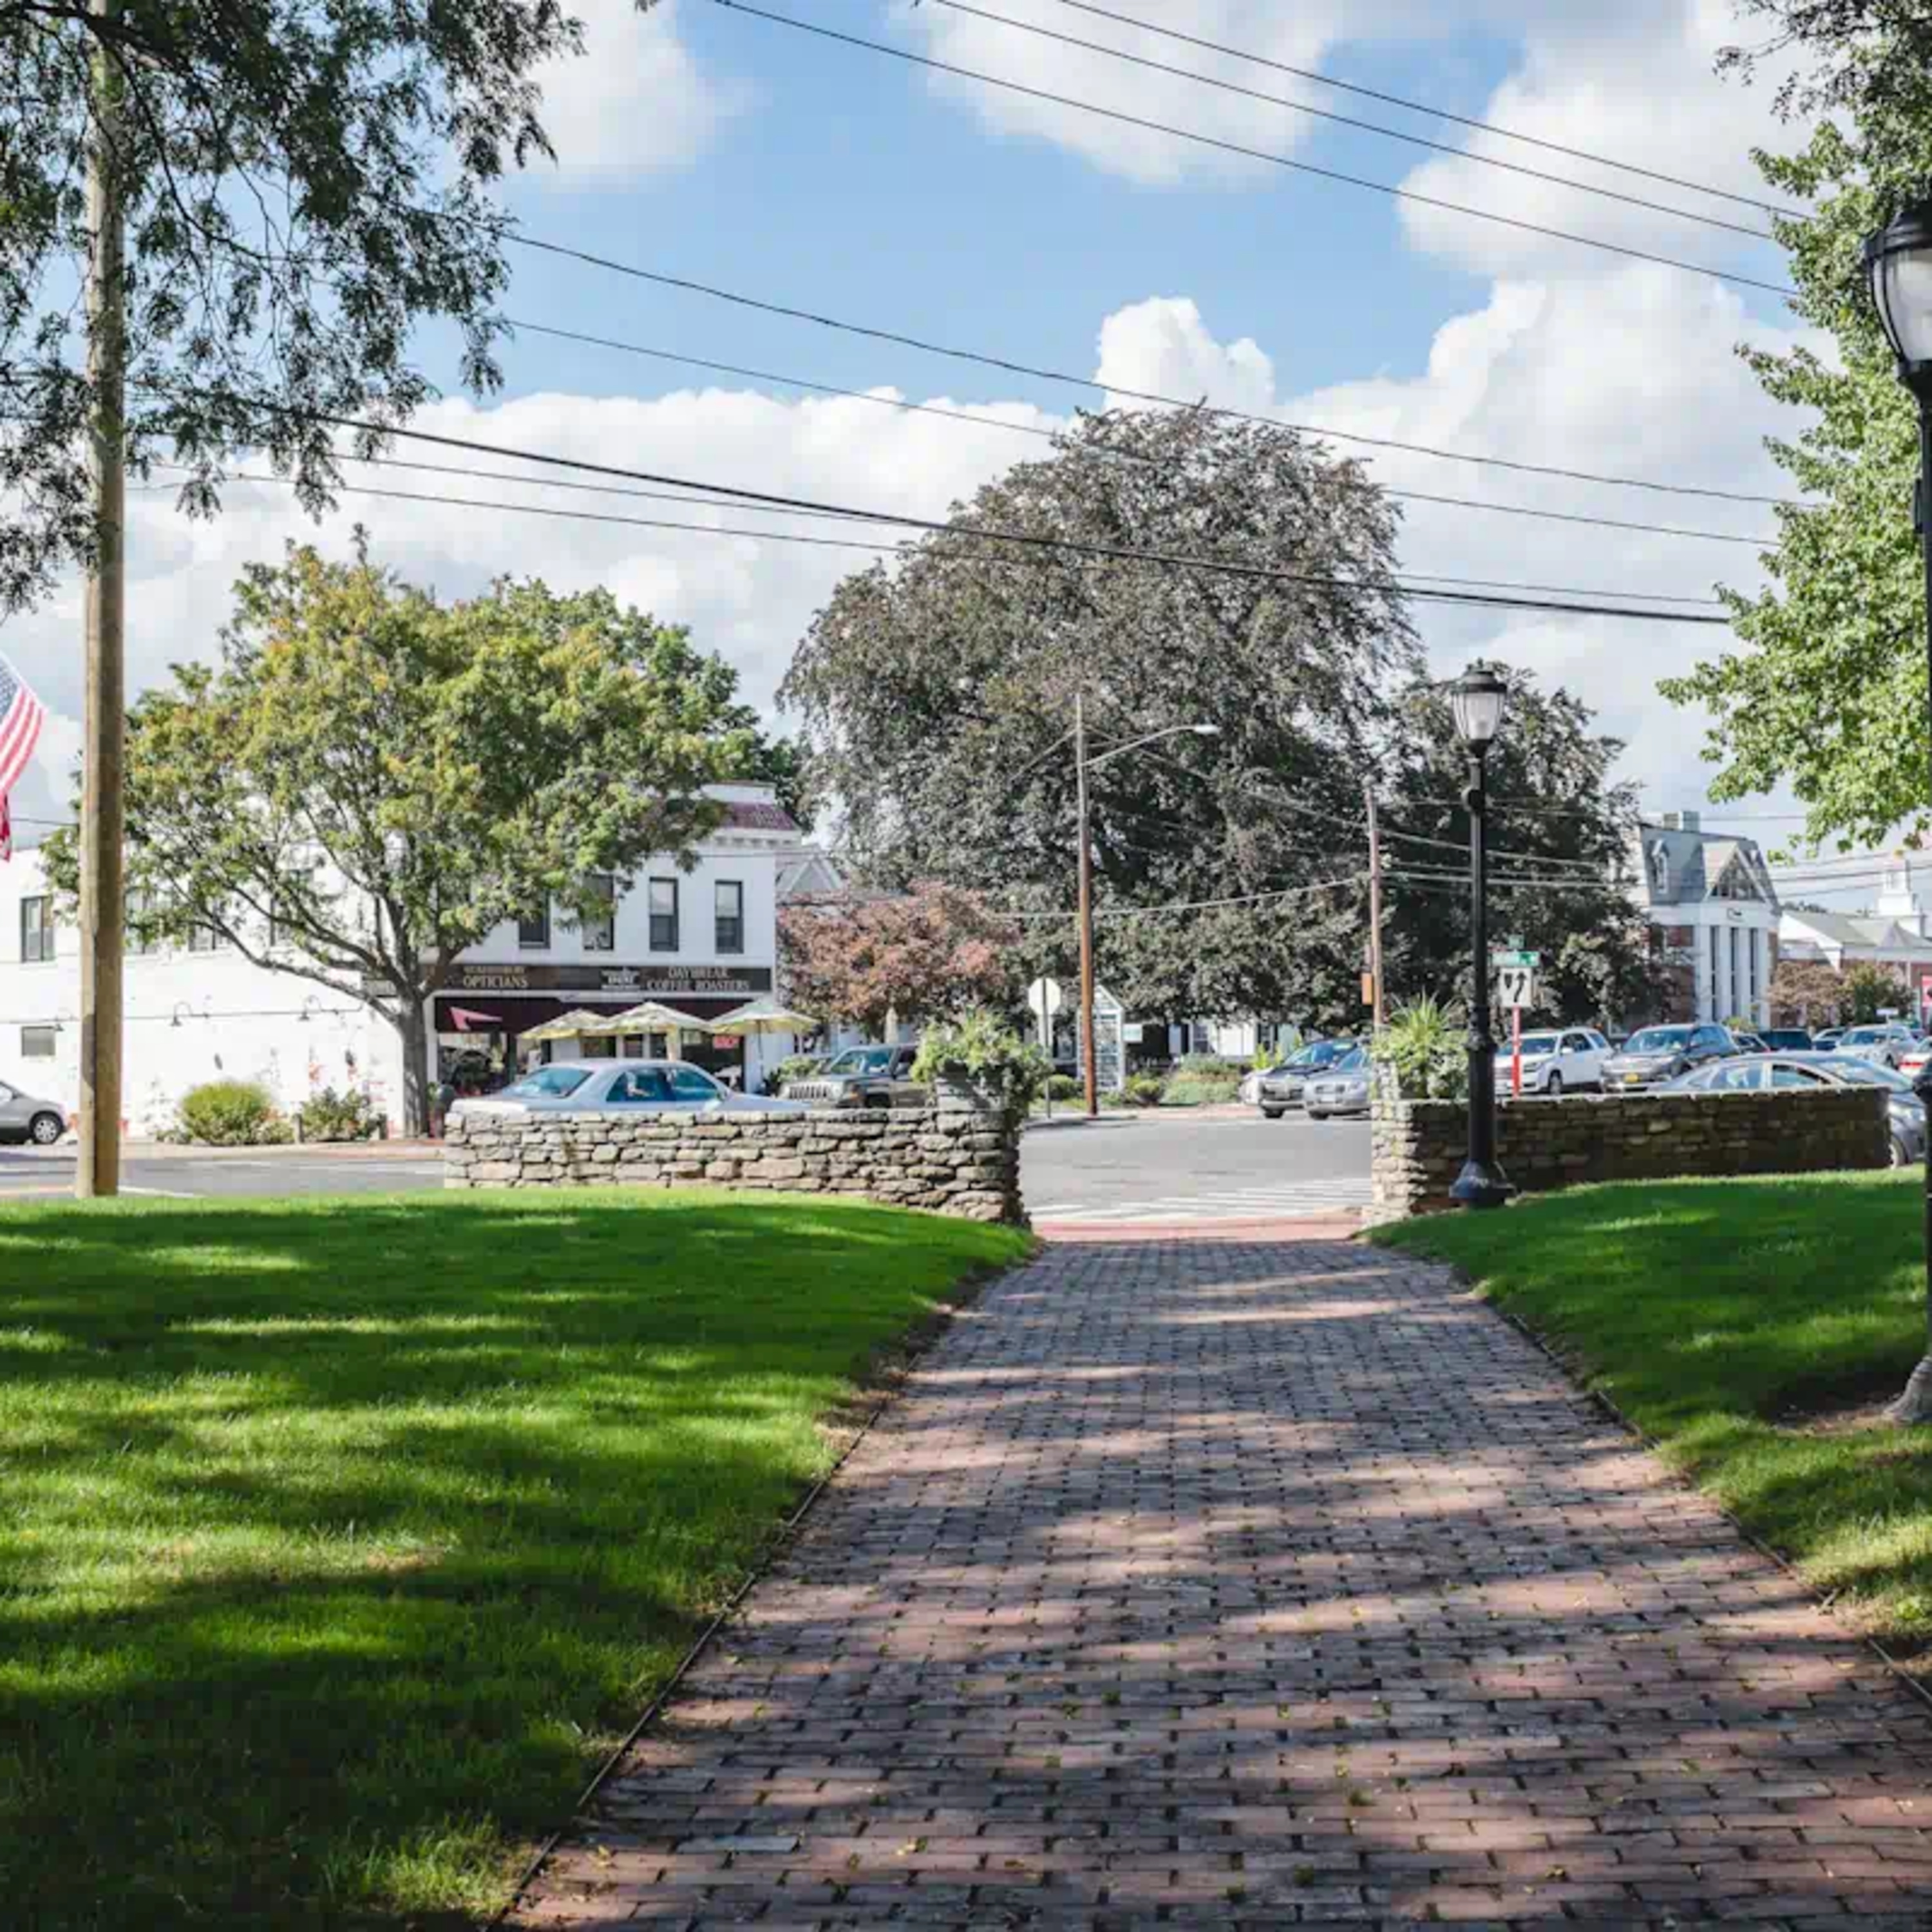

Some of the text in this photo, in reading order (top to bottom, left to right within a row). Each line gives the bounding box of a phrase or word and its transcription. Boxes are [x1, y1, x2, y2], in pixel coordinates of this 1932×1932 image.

[462, 974, 529, 989] OPTICIANS
[647, 978, 692, 991] COFFEE
[695, 979, 750, 991] ROASTERS
